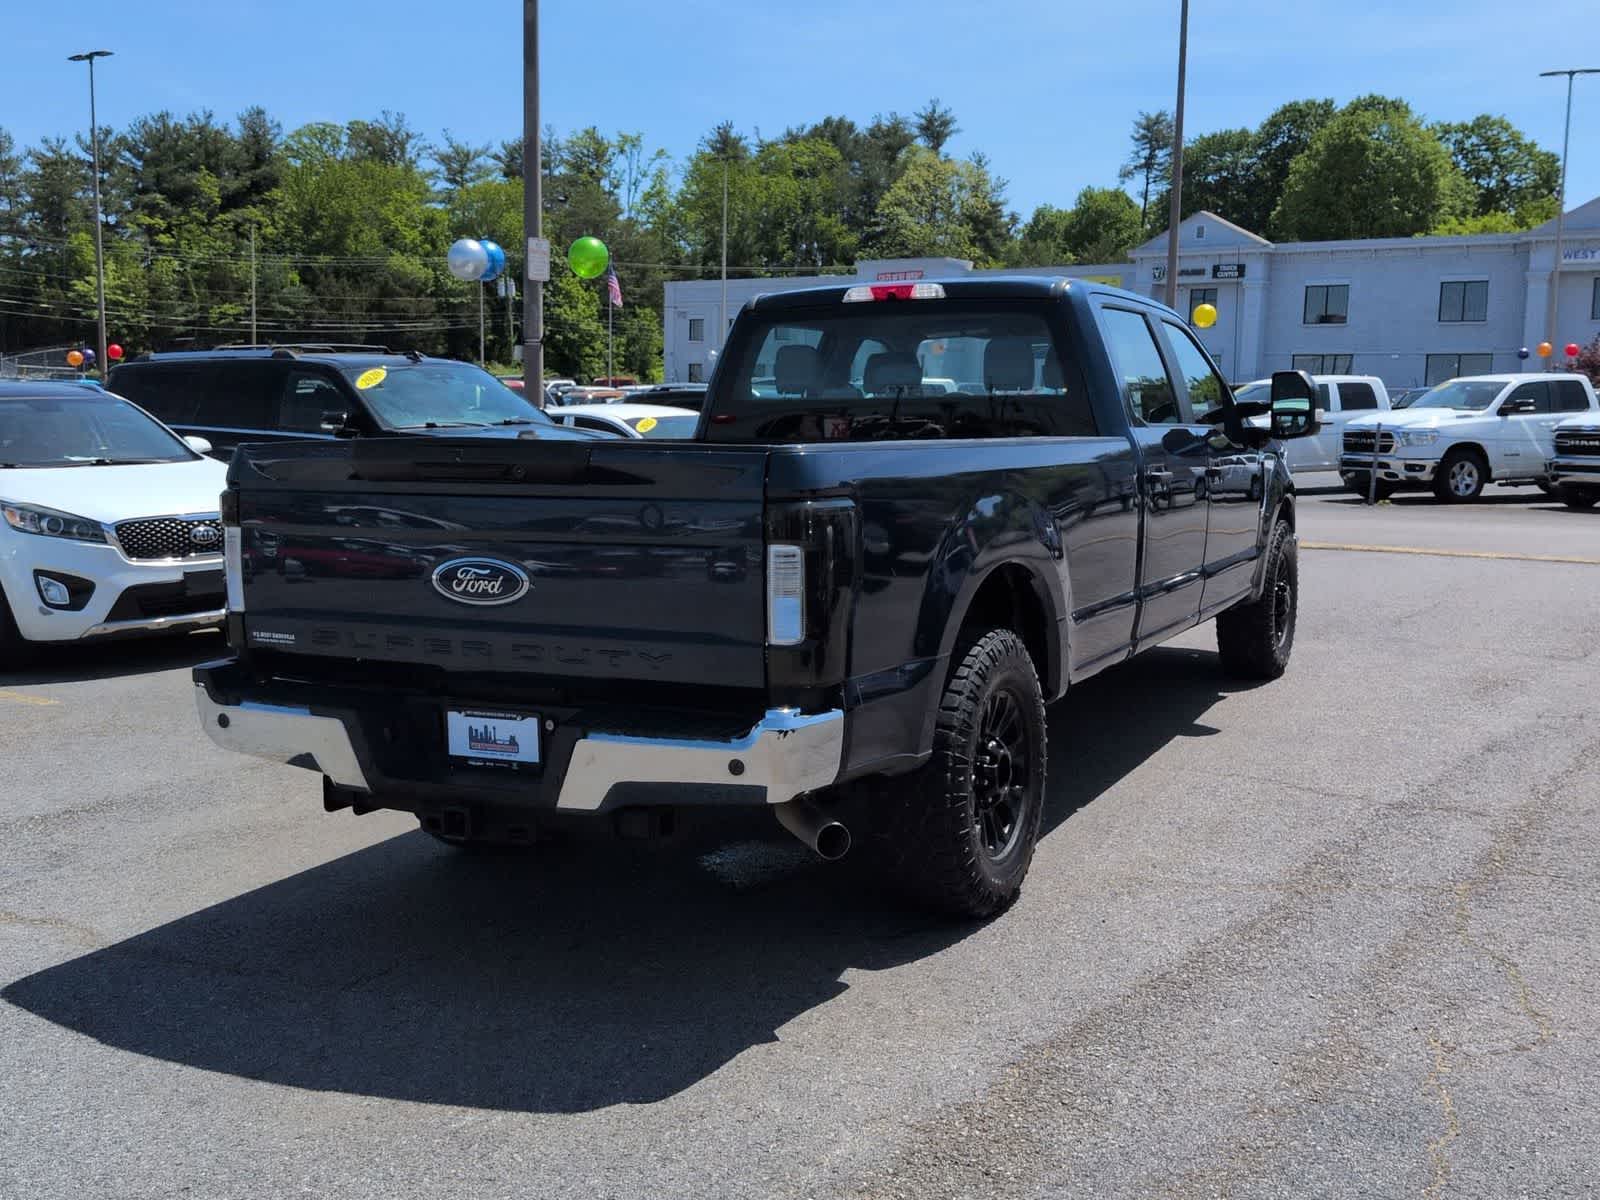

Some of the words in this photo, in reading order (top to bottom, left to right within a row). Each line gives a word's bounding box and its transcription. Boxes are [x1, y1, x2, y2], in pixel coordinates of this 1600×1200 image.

[195, 530, 216, 541] KIA
[452, 567, 504, 594] Ford
[310, 628, 494, 657] SUPER
[511, 642, 673, 670] DUTY
